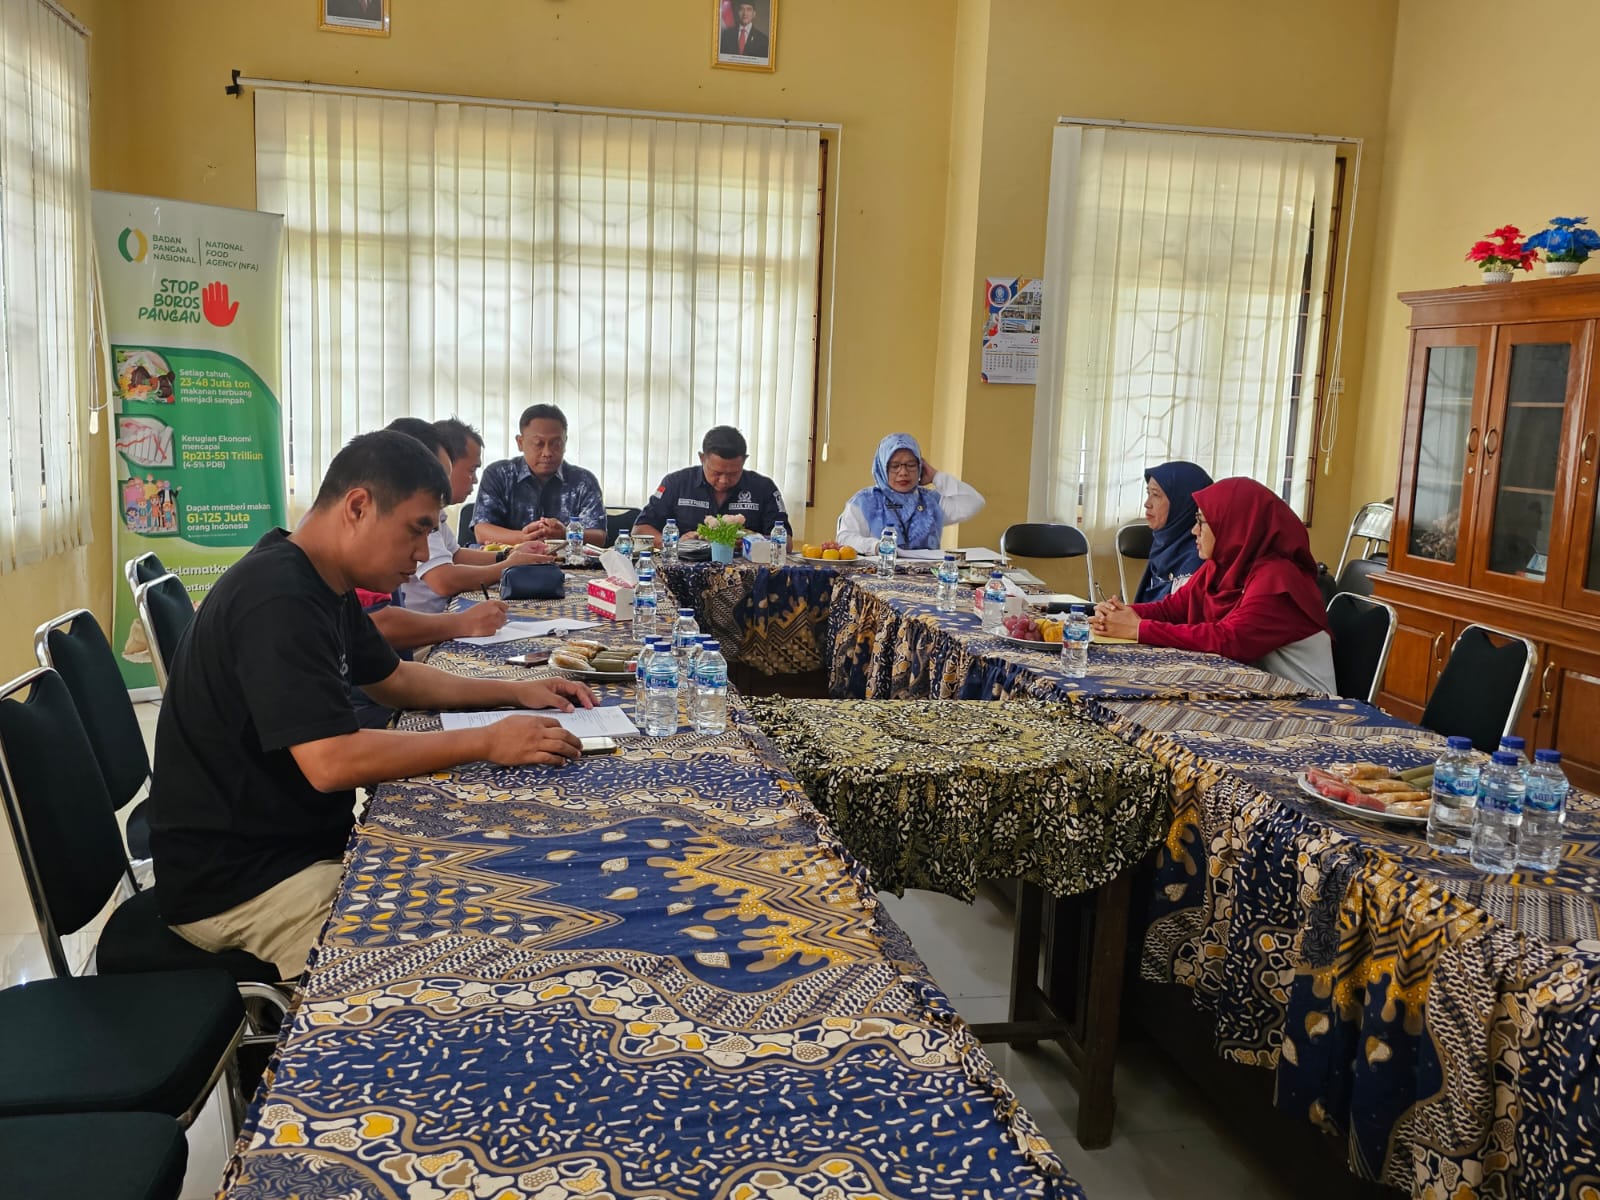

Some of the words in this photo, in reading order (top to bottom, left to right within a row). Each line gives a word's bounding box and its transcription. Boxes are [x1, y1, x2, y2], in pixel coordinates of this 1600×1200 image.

[153, 234, 182, 244] BADAN
[153, 243, 188, 254] PANGAN
[205, 240, 245, 252] NATIONAL
[153, 253, 196, 264] NASIONAL
[206, 249, 229, 258] FOOD
[206, 258, 238, 269] AGENCY
[238, 262, 259, 272] (NFA)
[160, 278, 199, 295] STOP
[153, 293, 200, 309] BOROS
[138, 307, 201, 324] PANGAN
[179, 369, 205, 379] Setiap
[180, 378, 209, 388] 23-48
[210, 379, 233, 388] Juta
[234, 380, 250, 388] ton
[180, 387, 217, 396] makanan
[218, 388, 252, 398] terbuang
[181, 395, 213, 404] menjadi
[214, 396, 244, 405] sampah
[182, 434, 218, 444] Kerugian
[218, 434, 252, 443] Ekonomi
[182, 442, 220, 452] mencapai
[182, 451, 230, 462] Rp213-551
[186, 503, 210, 513] Dapat
[211, 503, 246, 511] memberi
[247, 503, 271, 511] makan
[186, 513, 222, 524] 61-125
[224, 512, 250, 523] Juta
[187, 523, 211, 532] orang
[212, 522, 248, 531] Indonesia
